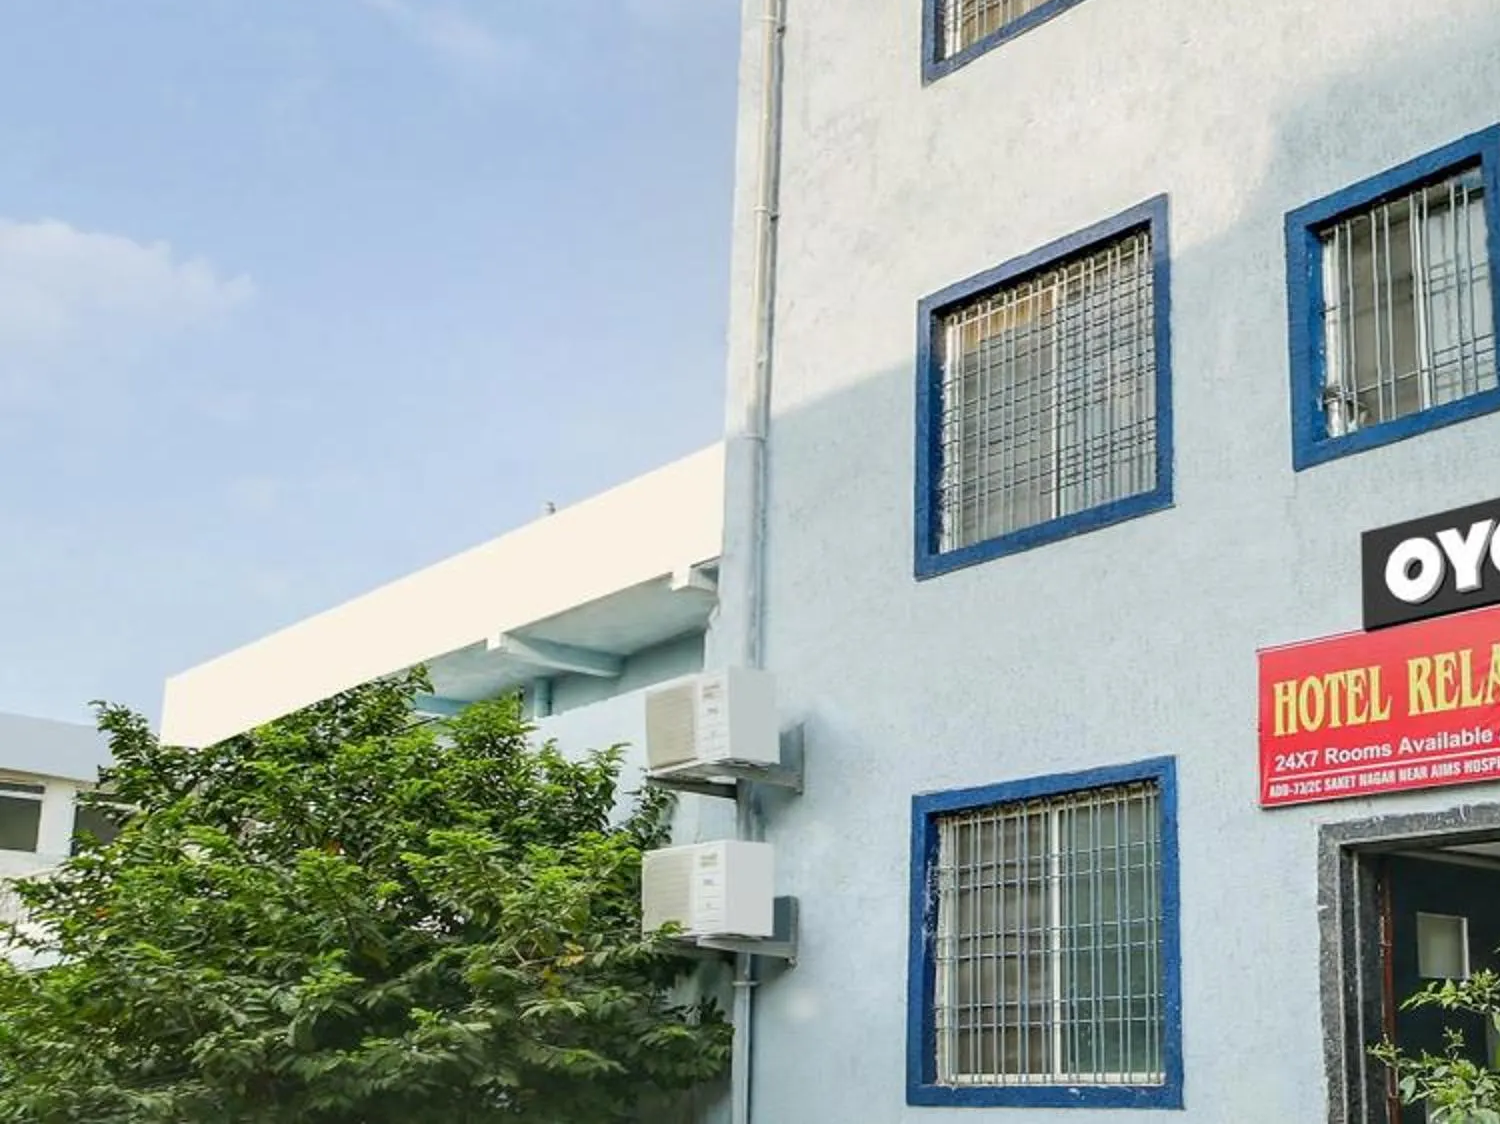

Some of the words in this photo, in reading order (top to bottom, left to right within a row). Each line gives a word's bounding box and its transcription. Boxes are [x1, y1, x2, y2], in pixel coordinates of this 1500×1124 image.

[1273, 666, 1391, 737] HOTEL
[1274, 749, 1320, 773] 24X7
[1324, 742, 1393, 766] Rooms
[1398, 725, 1493, 755] Available
